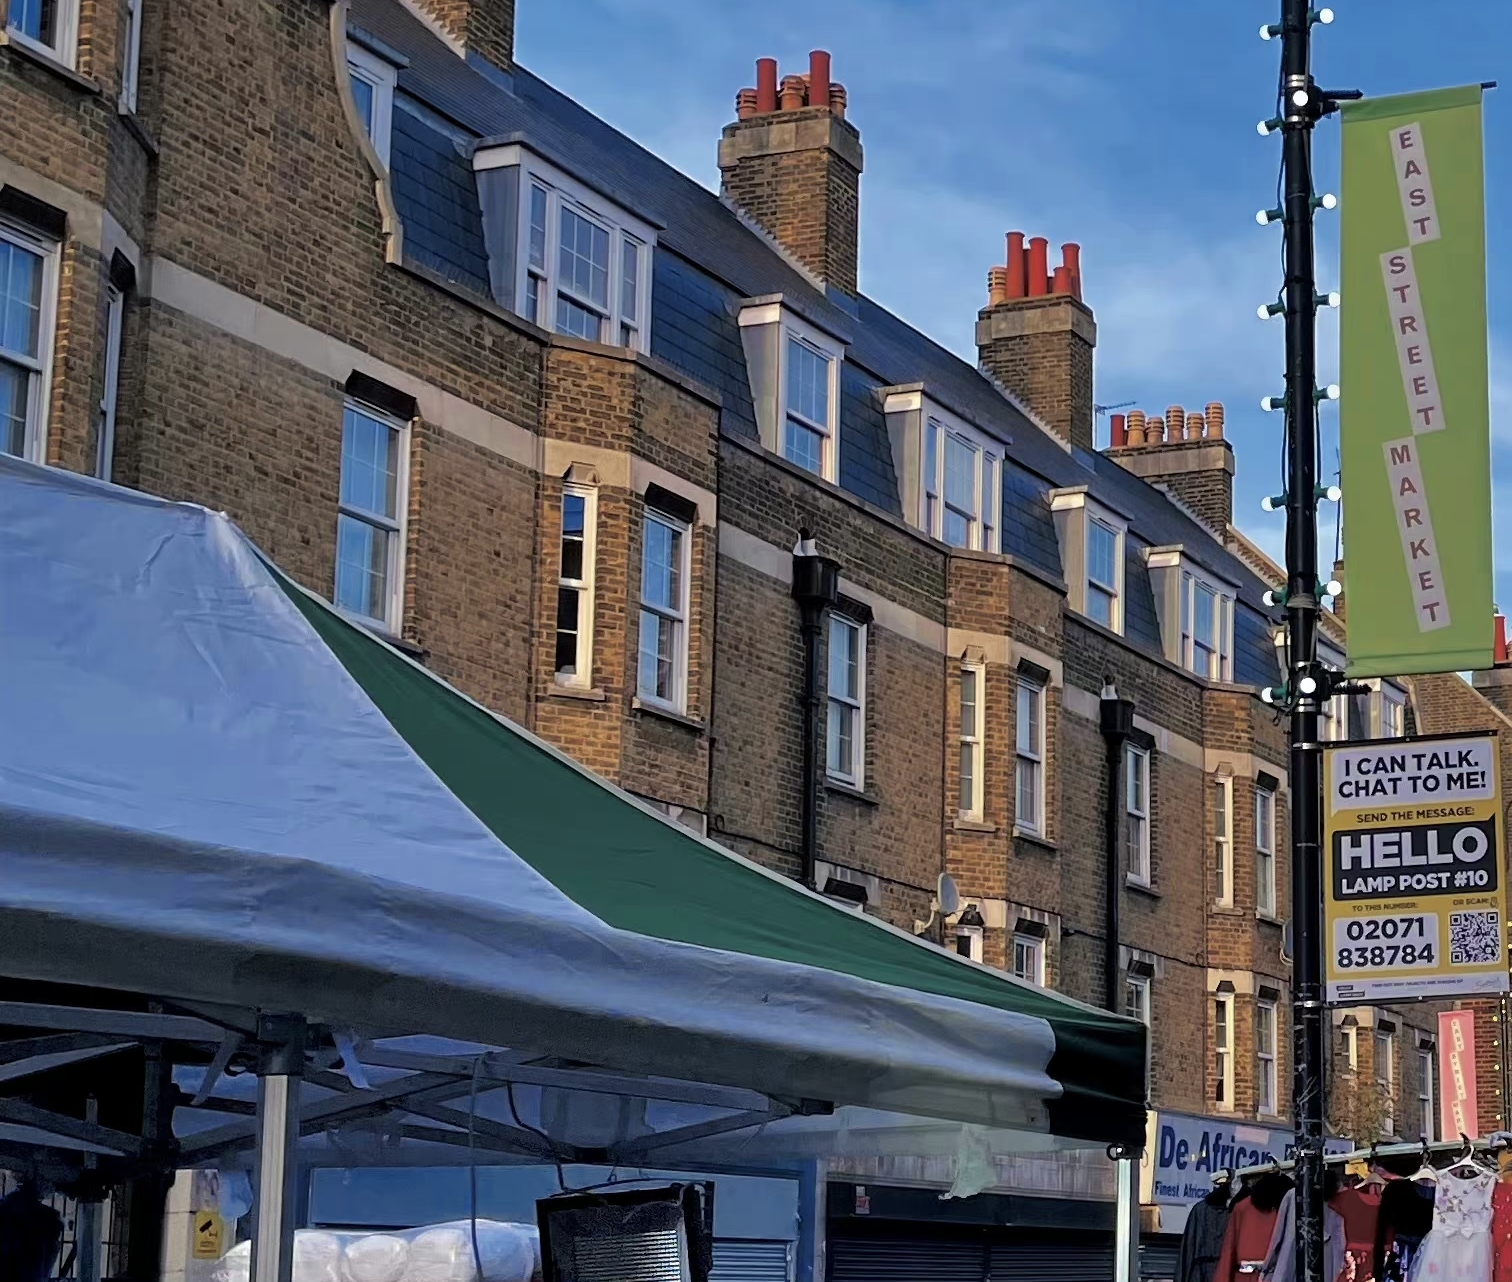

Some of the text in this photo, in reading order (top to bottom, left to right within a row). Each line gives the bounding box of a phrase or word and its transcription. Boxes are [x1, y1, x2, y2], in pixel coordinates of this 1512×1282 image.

[1398, 129, 1433, 237] EAST
[1388, 253, 1435, 427] STREET
[1390, 443, 1440, 624] MARKET
[1344, 750, 1479, 777] I CAN TALK.
[1338, 770, 1486, 799] CHAT TO ME!
[1356, 806, 1475, 823] SEND THE MESSAGE:
[1340, 826, 1489, 871] HELLO
[1341, 869, 1489, 895] LAMP POST #10
[1352, 904, 1363, 912] TO
[1364, 903, 1382, 912] THIS
[1346, 916, 1425, 942] 02071
[1337, 942, 1435, 969] 838784
[1159, 1124, 1189, 1171] De
[1195, 1131, 1274, 1174] African
[1154, 1180, 1180, 1197] Finest
